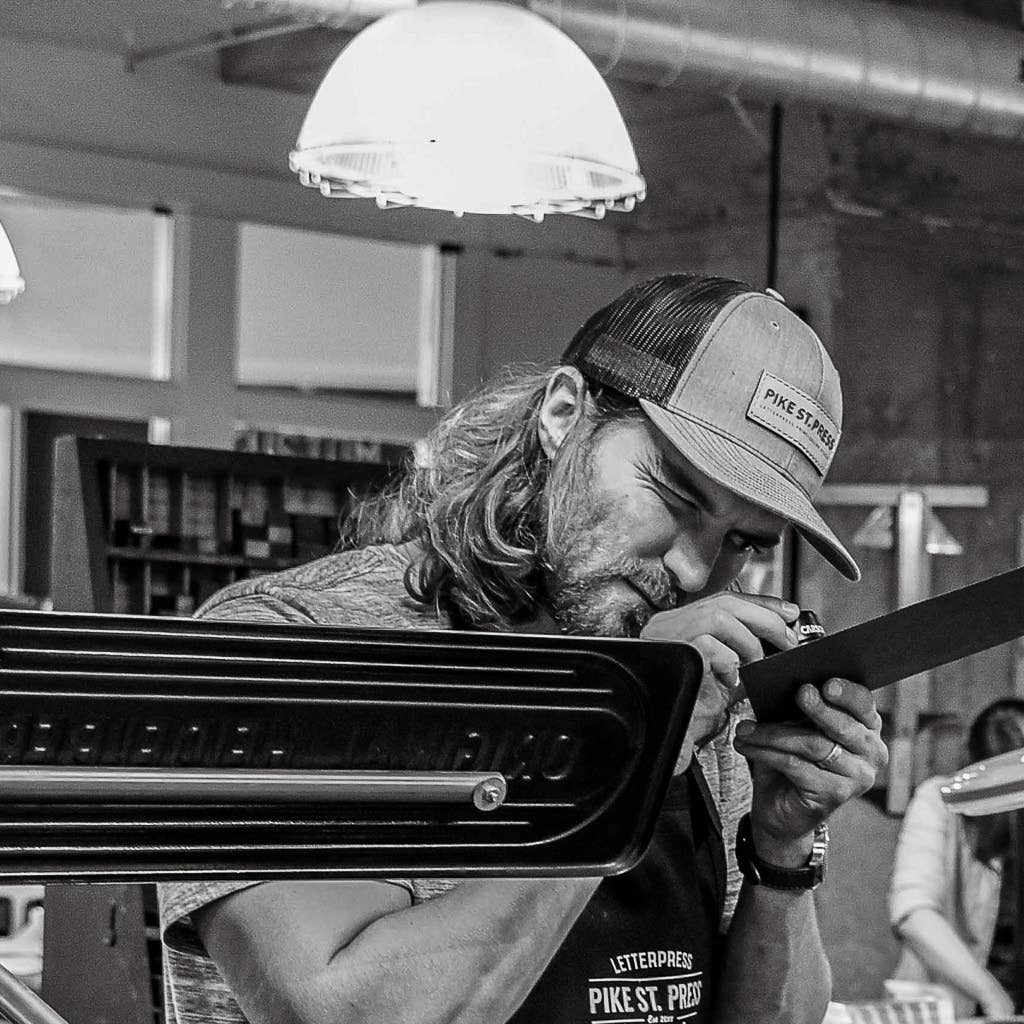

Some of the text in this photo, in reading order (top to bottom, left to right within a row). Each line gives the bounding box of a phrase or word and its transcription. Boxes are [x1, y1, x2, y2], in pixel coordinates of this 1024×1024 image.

[763, 388, 797, 415] PIKE
[811, 420, 836, 451] PRESS
[610, 950, 693, 974] LETTERPRESS
[588, 980, 702, 1014] PIKE ST. PRESS
